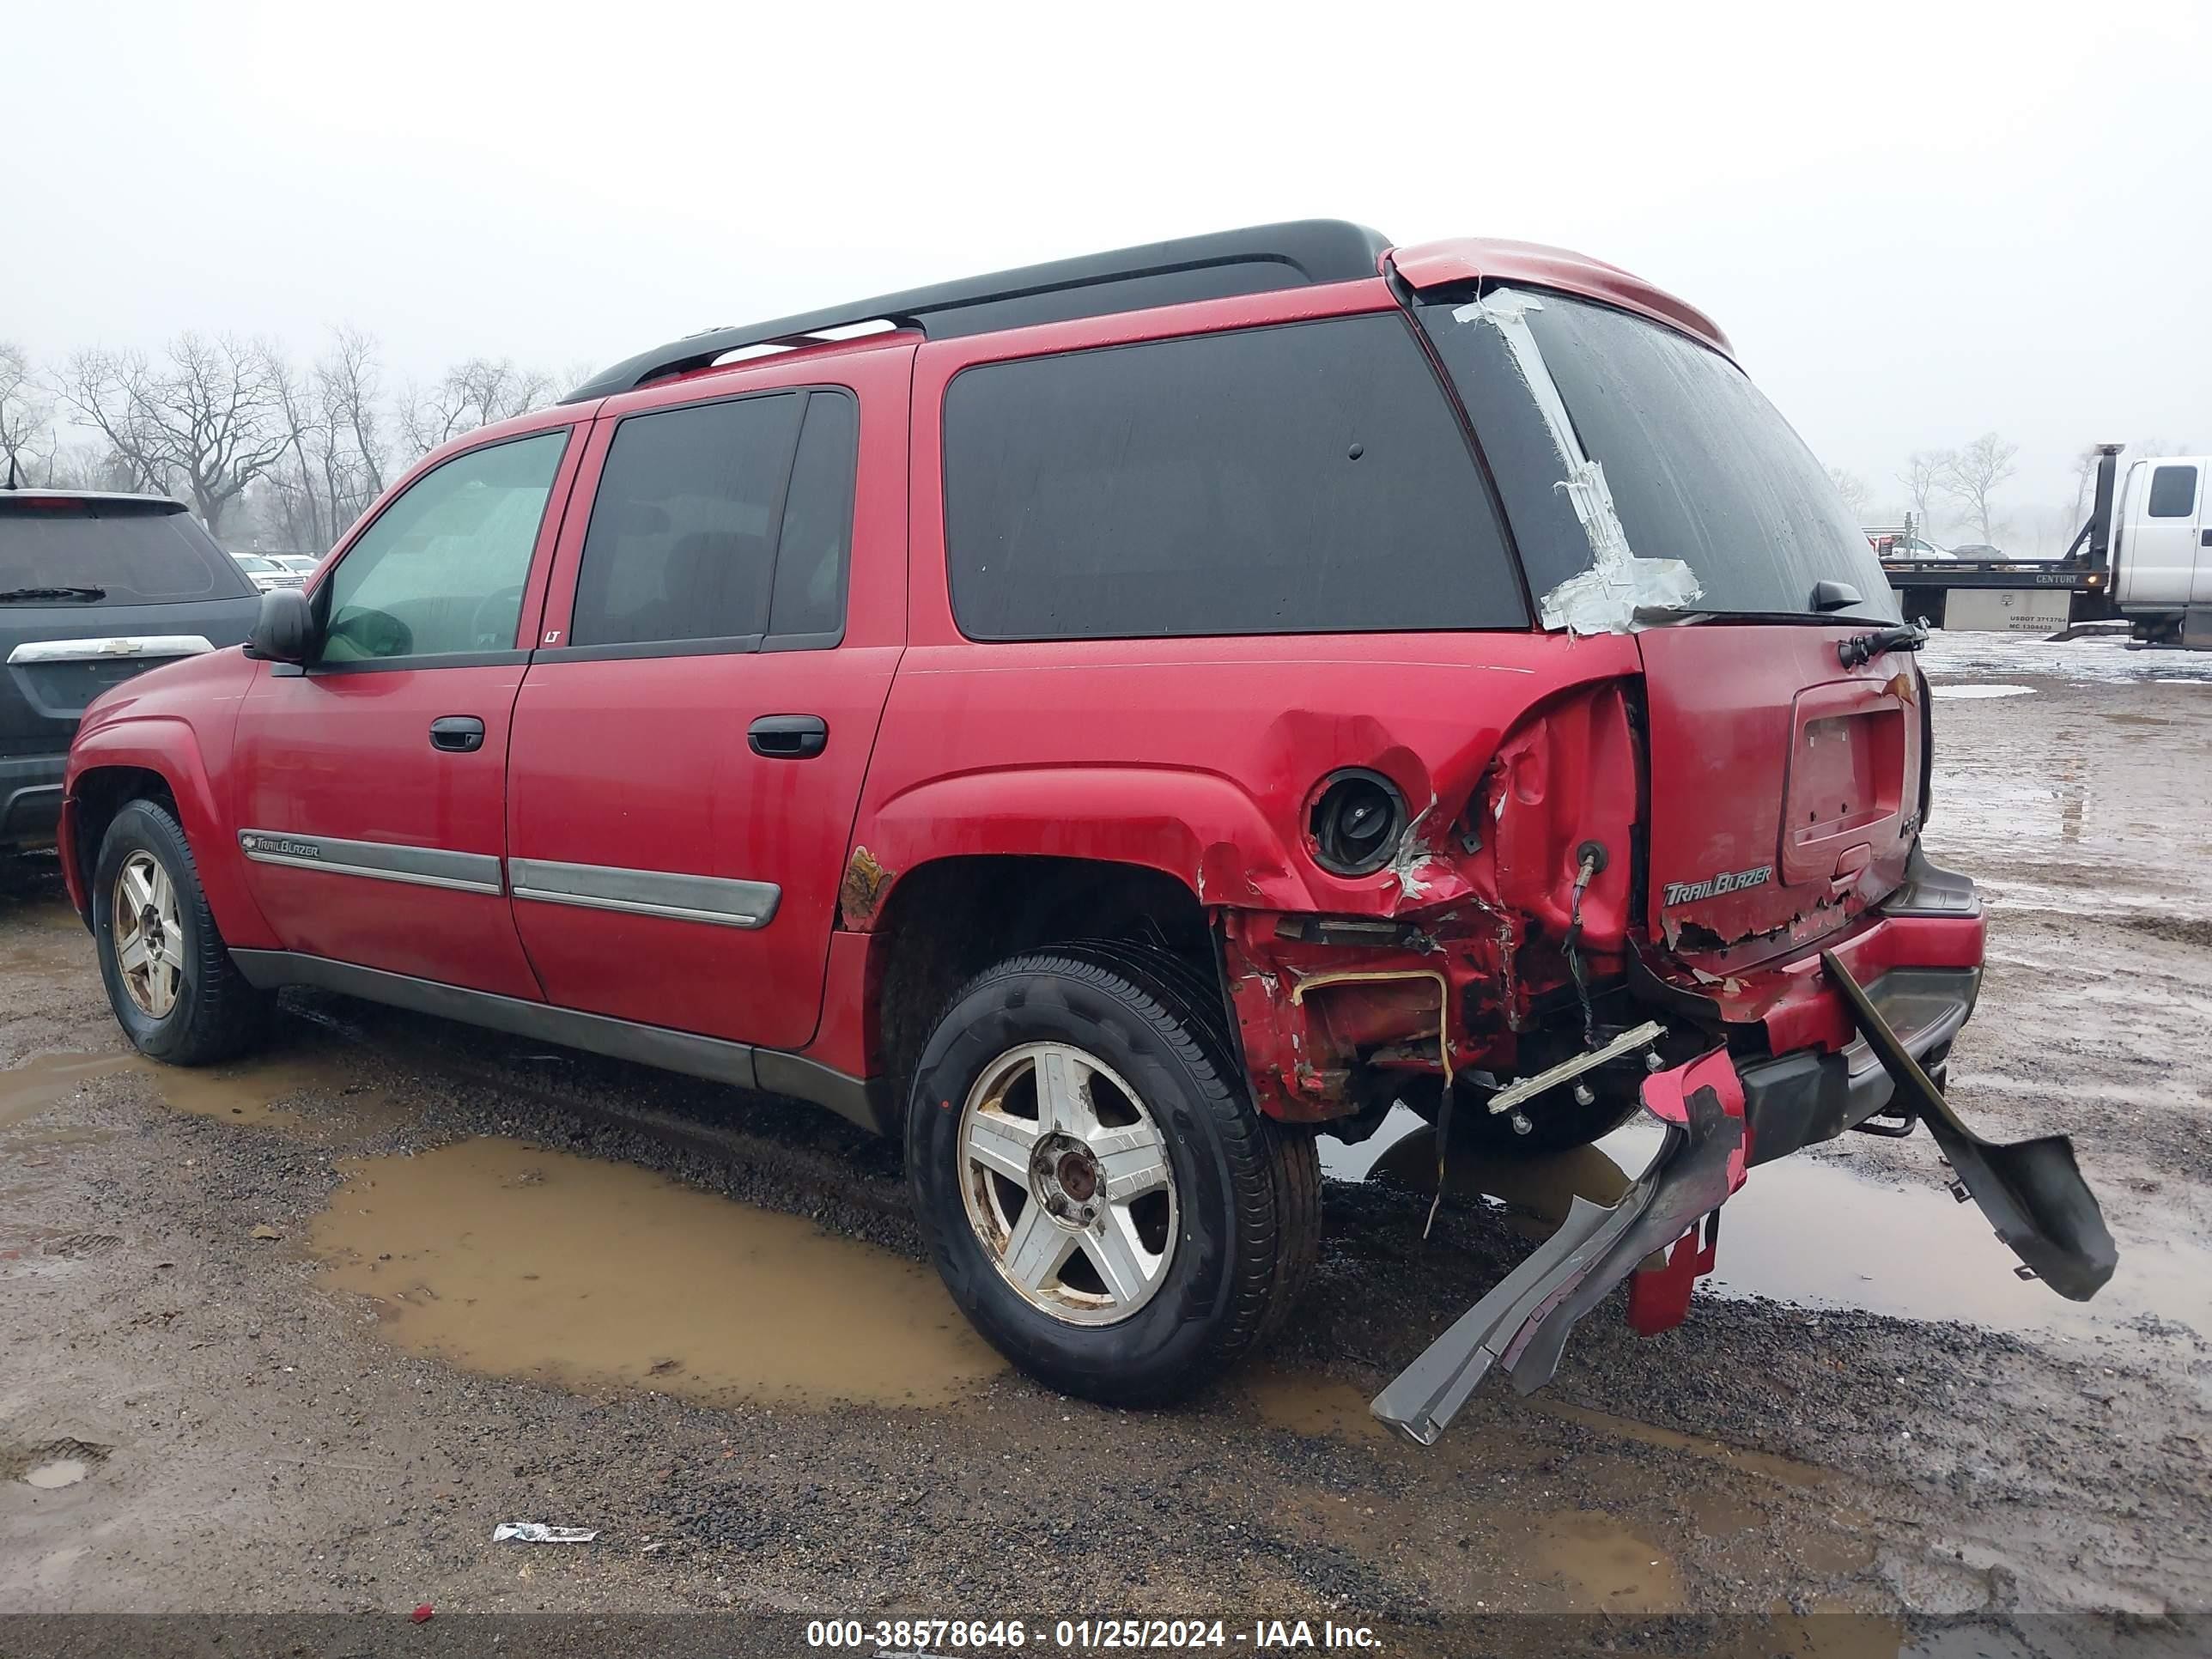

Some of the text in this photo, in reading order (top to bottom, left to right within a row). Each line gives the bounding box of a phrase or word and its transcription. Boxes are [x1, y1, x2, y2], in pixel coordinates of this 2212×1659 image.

[2036, 574, 2077, 583] CENTURY
[544, 631, 561, 643] LT
[257, 837, 319, 857] TRAILBLAZER
[1662, 864, 1773, 908] TRAILBLAZER
